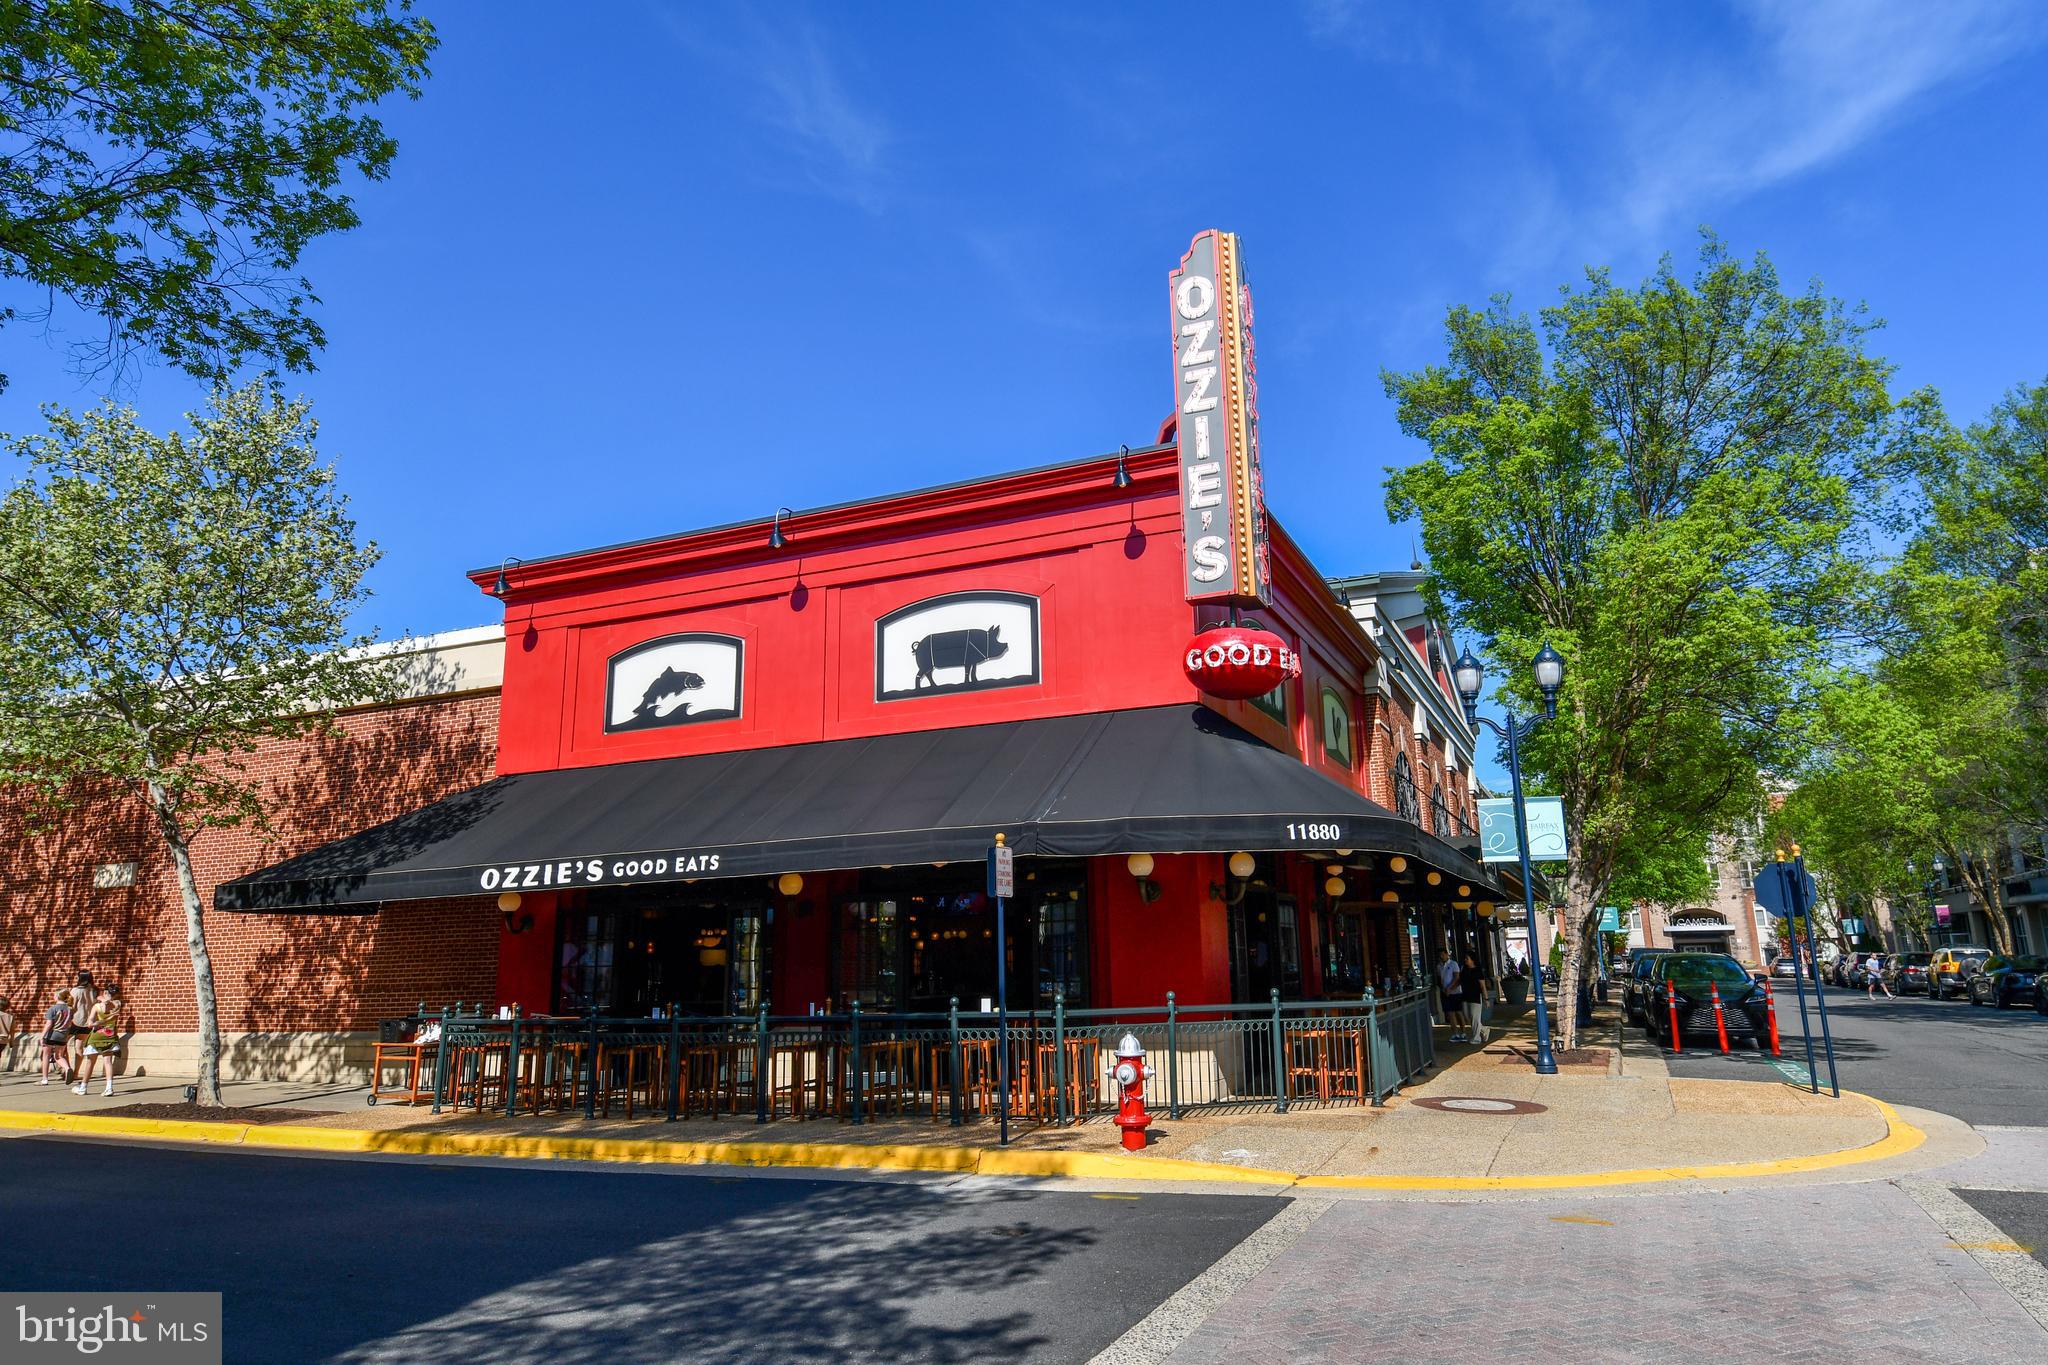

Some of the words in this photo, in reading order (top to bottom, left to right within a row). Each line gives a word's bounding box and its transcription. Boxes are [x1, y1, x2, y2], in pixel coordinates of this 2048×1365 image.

[1176, 276, 1228, 584] OZZIE'S
[1186, 643, 1272, 671] GOOD
[1286, 823, 1341, 841] 11880
[1530, 822, 1559, 830] FAIRFAX
[480, 859, 604, 890] OZZIE'S
[612, 858, 668, 878] GOOD
[675, 854, 721, 874] EATS
[1676, 917, 1720, 927] CAMDEN
